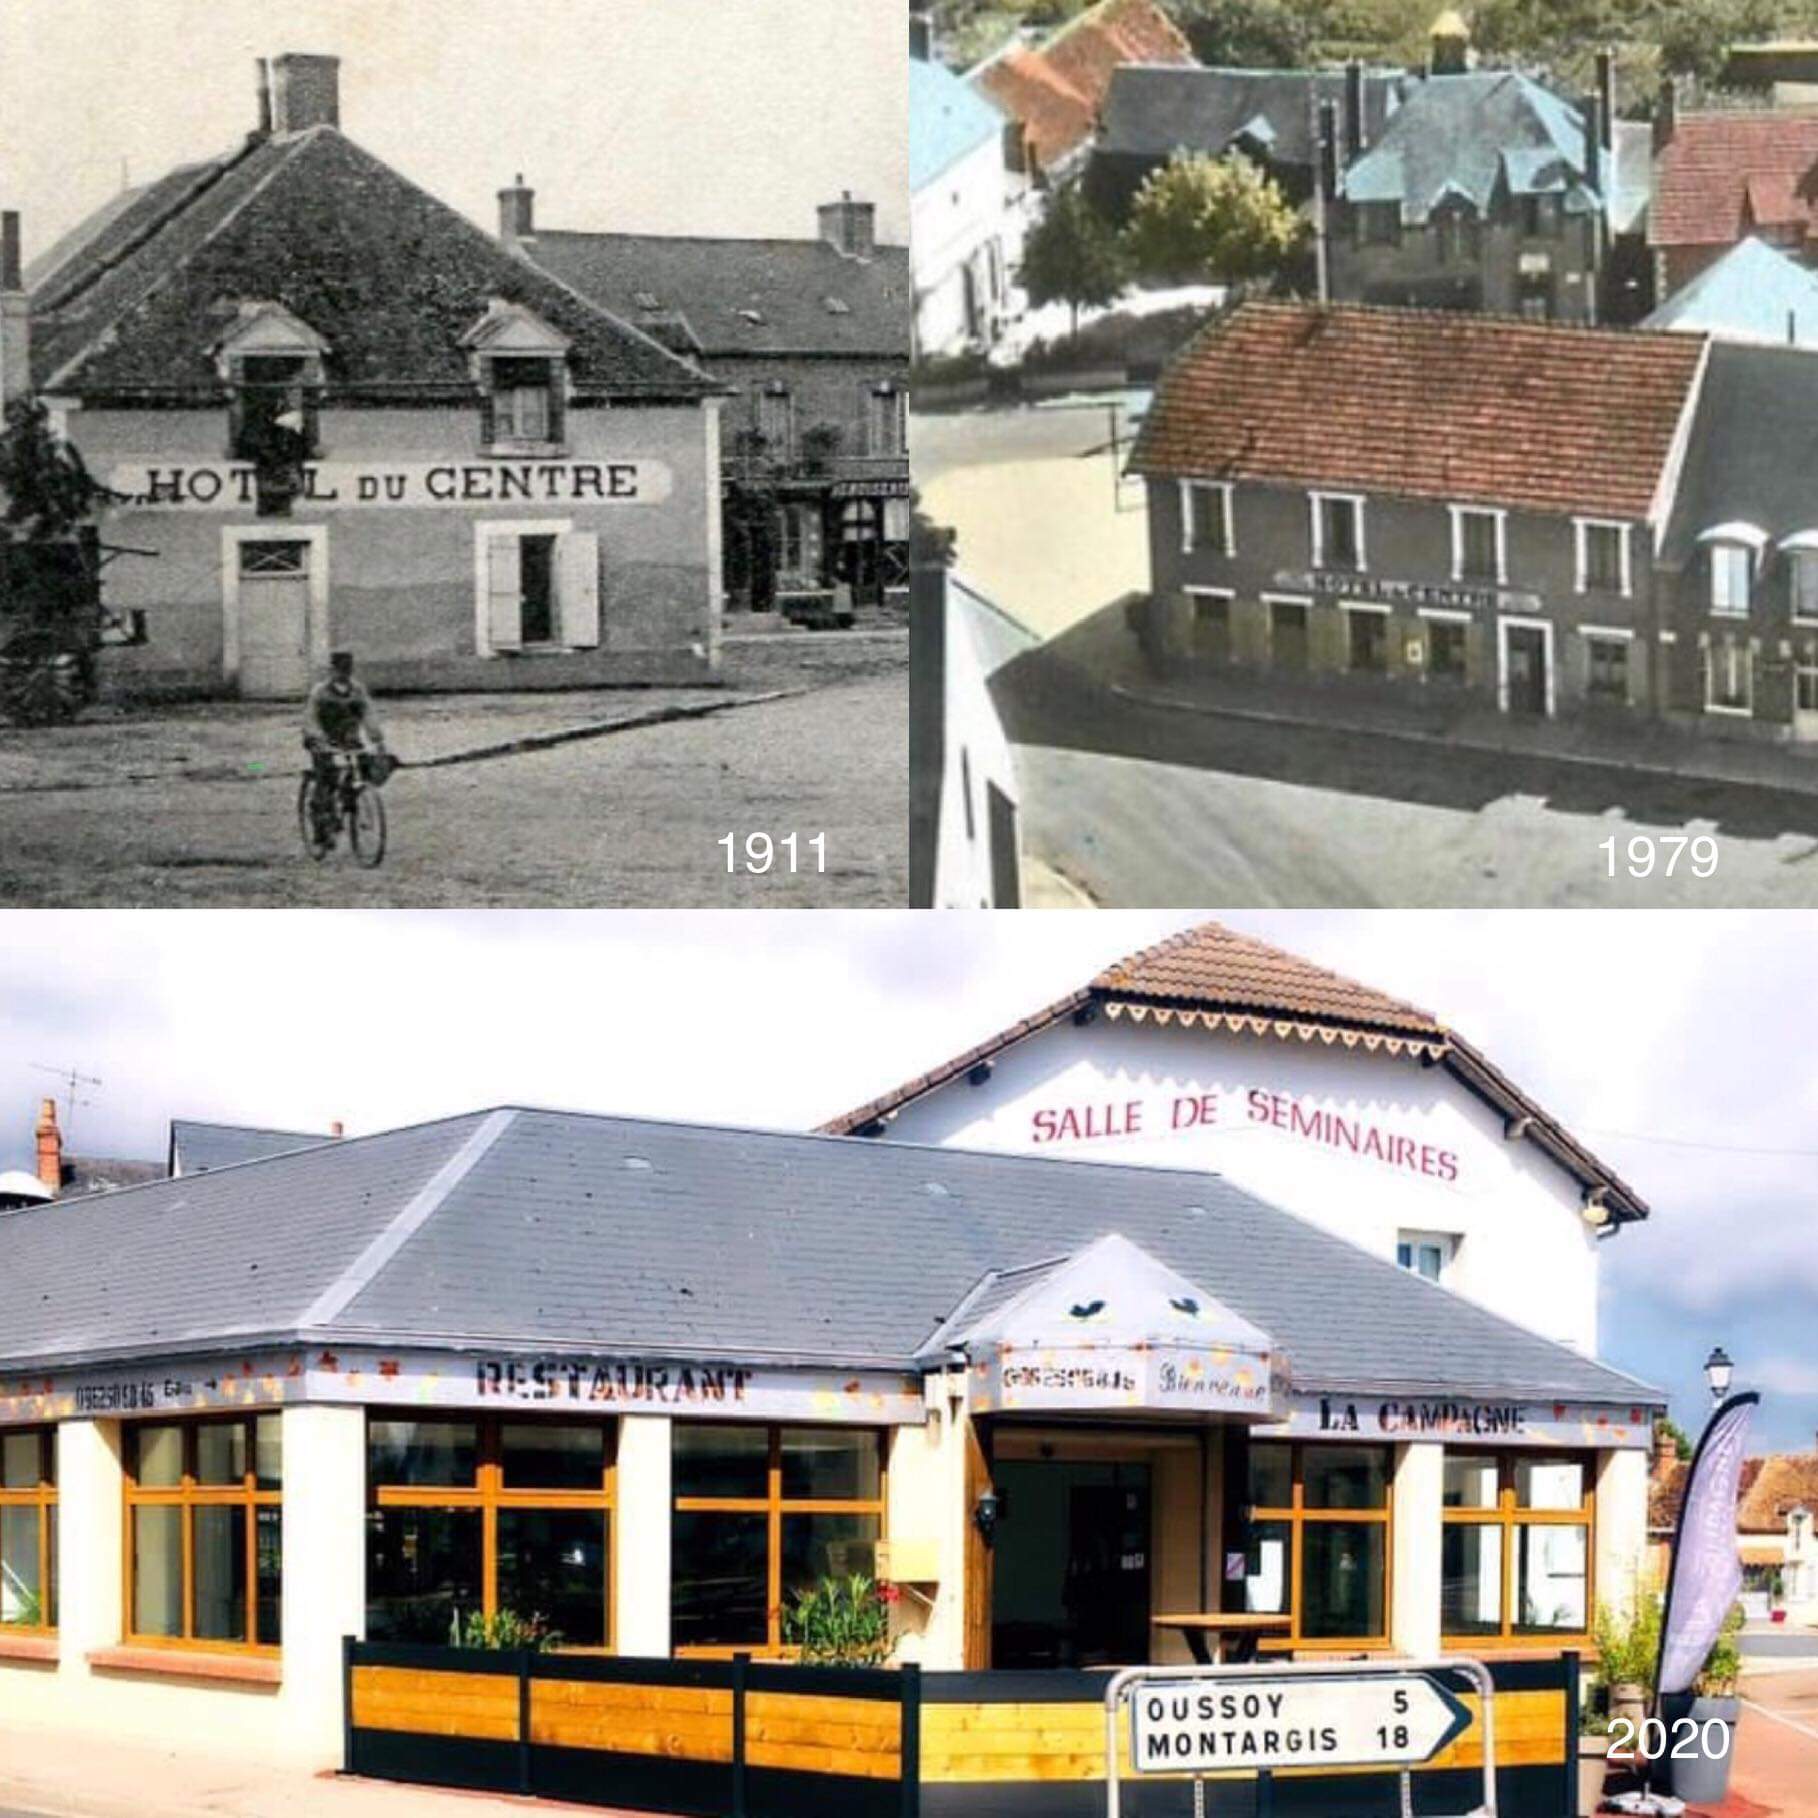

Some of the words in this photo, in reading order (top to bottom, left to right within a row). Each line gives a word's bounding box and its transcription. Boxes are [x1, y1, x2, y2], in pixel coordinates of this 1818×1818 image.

[147, 468, 338, 504] HOTL
[358, 474, 406, 501] DU
[425, 464, 638, 500] CENTRE
[1032, 1100, 1143, 1143] SALLE
[1171, 1094, 1218, 1130] DE
[1247, 1089, 1460, 1182] SEMINAIRES
[476, 1360, 754, 1403] RESTAURANT
[1319, 1399, 1360, 1431] LA
[1377, 1402, 1528, 1435] CAMPAGNE
[1147, 1693, 1284, 1723] OUSSOY
[1394, 1690, 1410, 1715] 5
[1147, 1728, 1339, 1759] MONTARGIS
[1376, 1726, 1410, 1749] 18
